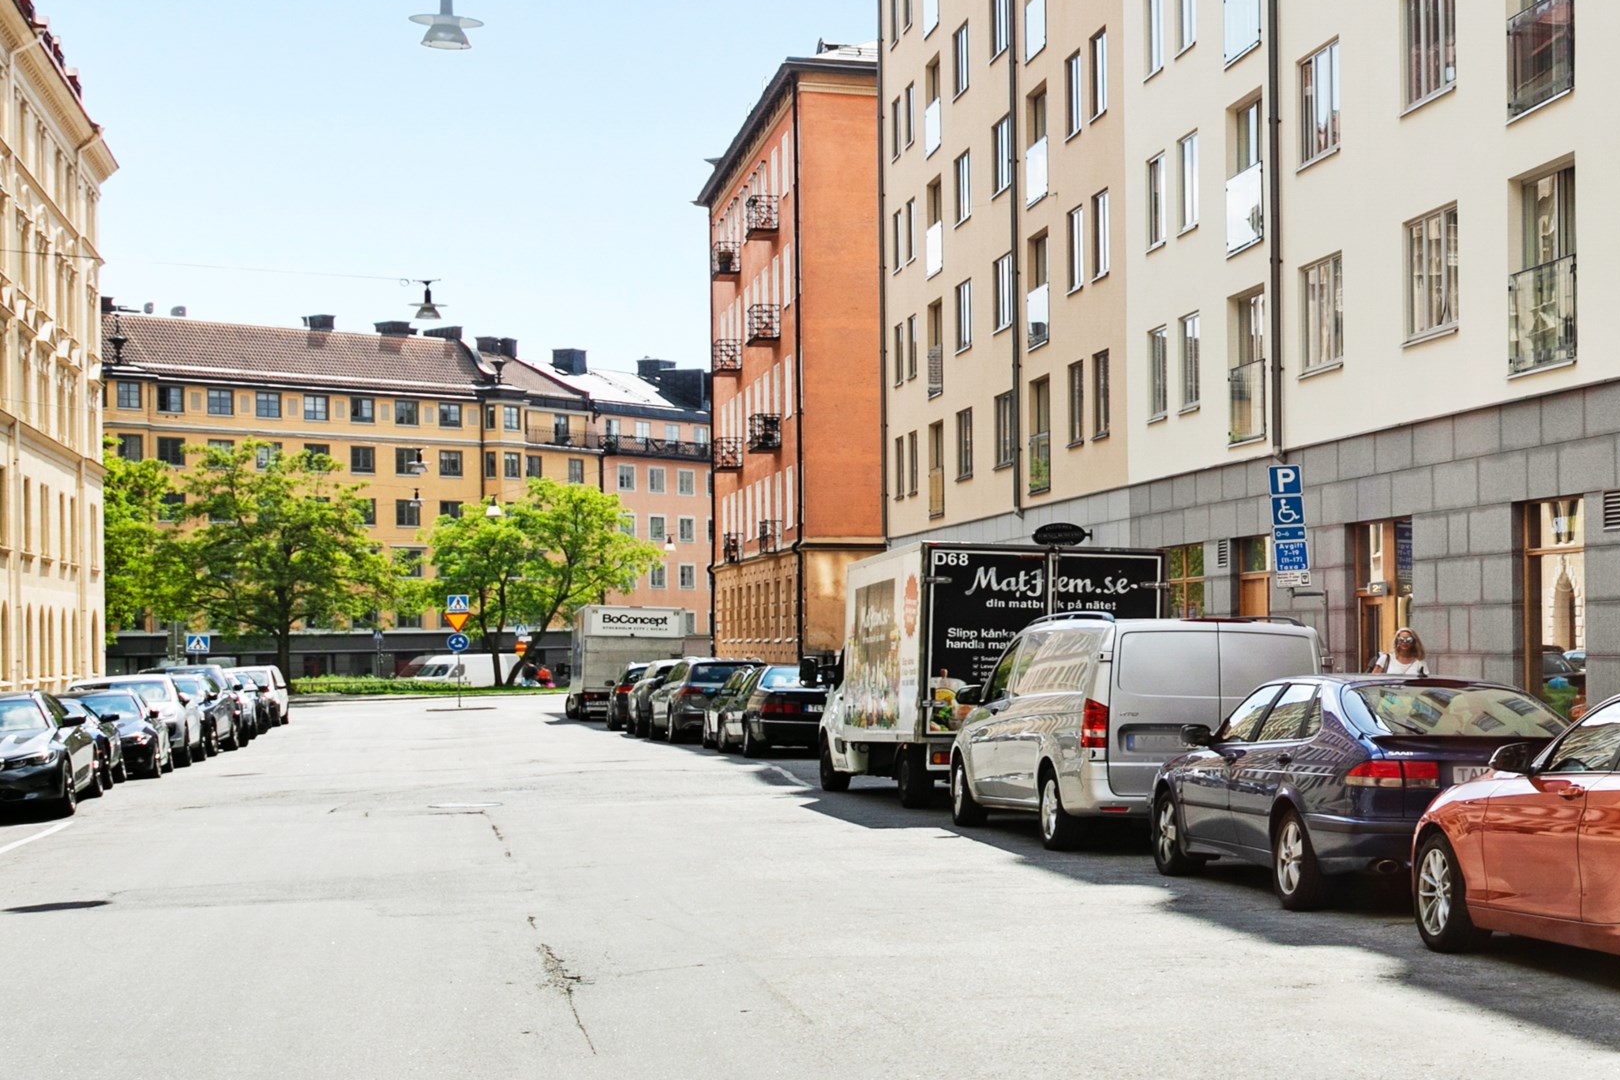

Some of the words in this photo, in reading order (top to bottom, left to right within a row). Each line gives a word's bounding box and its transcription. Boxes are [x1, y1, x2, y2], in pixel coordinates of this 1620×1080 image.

[1277, 468, 1296, 493] P
[1279, 542, 1303, 550] Avgift
[934, 552, 969, 566] D68
[986, 598, 1005, 608] din
[1067, 600, 1082, 610] på
[602, 613, 668, 627] BoConcept
[947, 627, 978, 639] Slipp
[946, 639, 985, 649] handla
